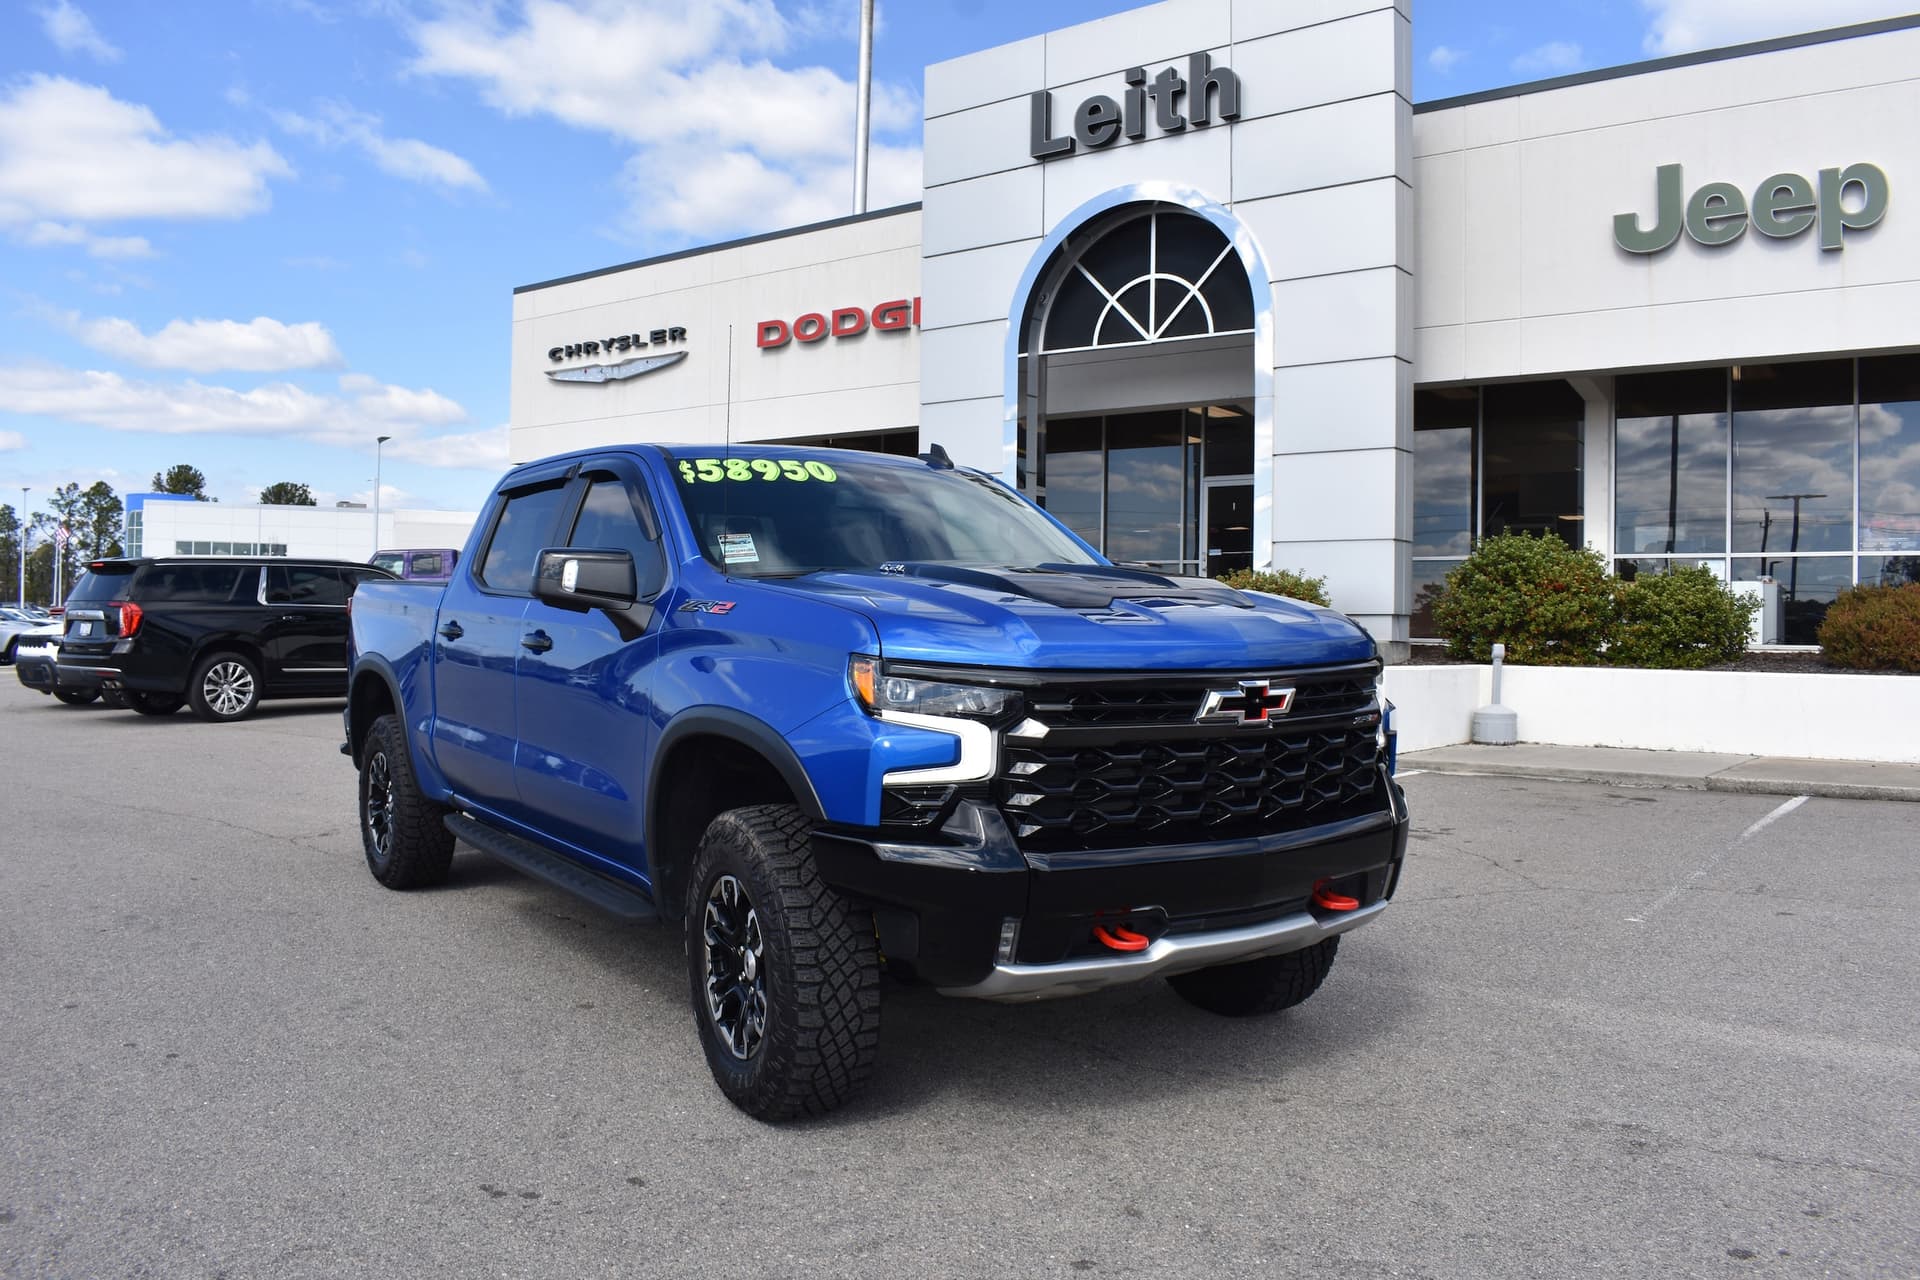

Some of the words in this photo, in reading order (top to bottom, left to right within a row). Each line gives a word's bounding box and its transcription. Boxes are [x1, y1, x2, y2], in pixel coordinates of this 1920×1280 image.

[1031, 51, 1241, 160] Leith
[1612, 162, 1889, 253] Jeep
[548, 326, 687, 361] CHRYSLER
[678, 458, 837, 484] $58950
[677, 599, 737, 615] ZR2
